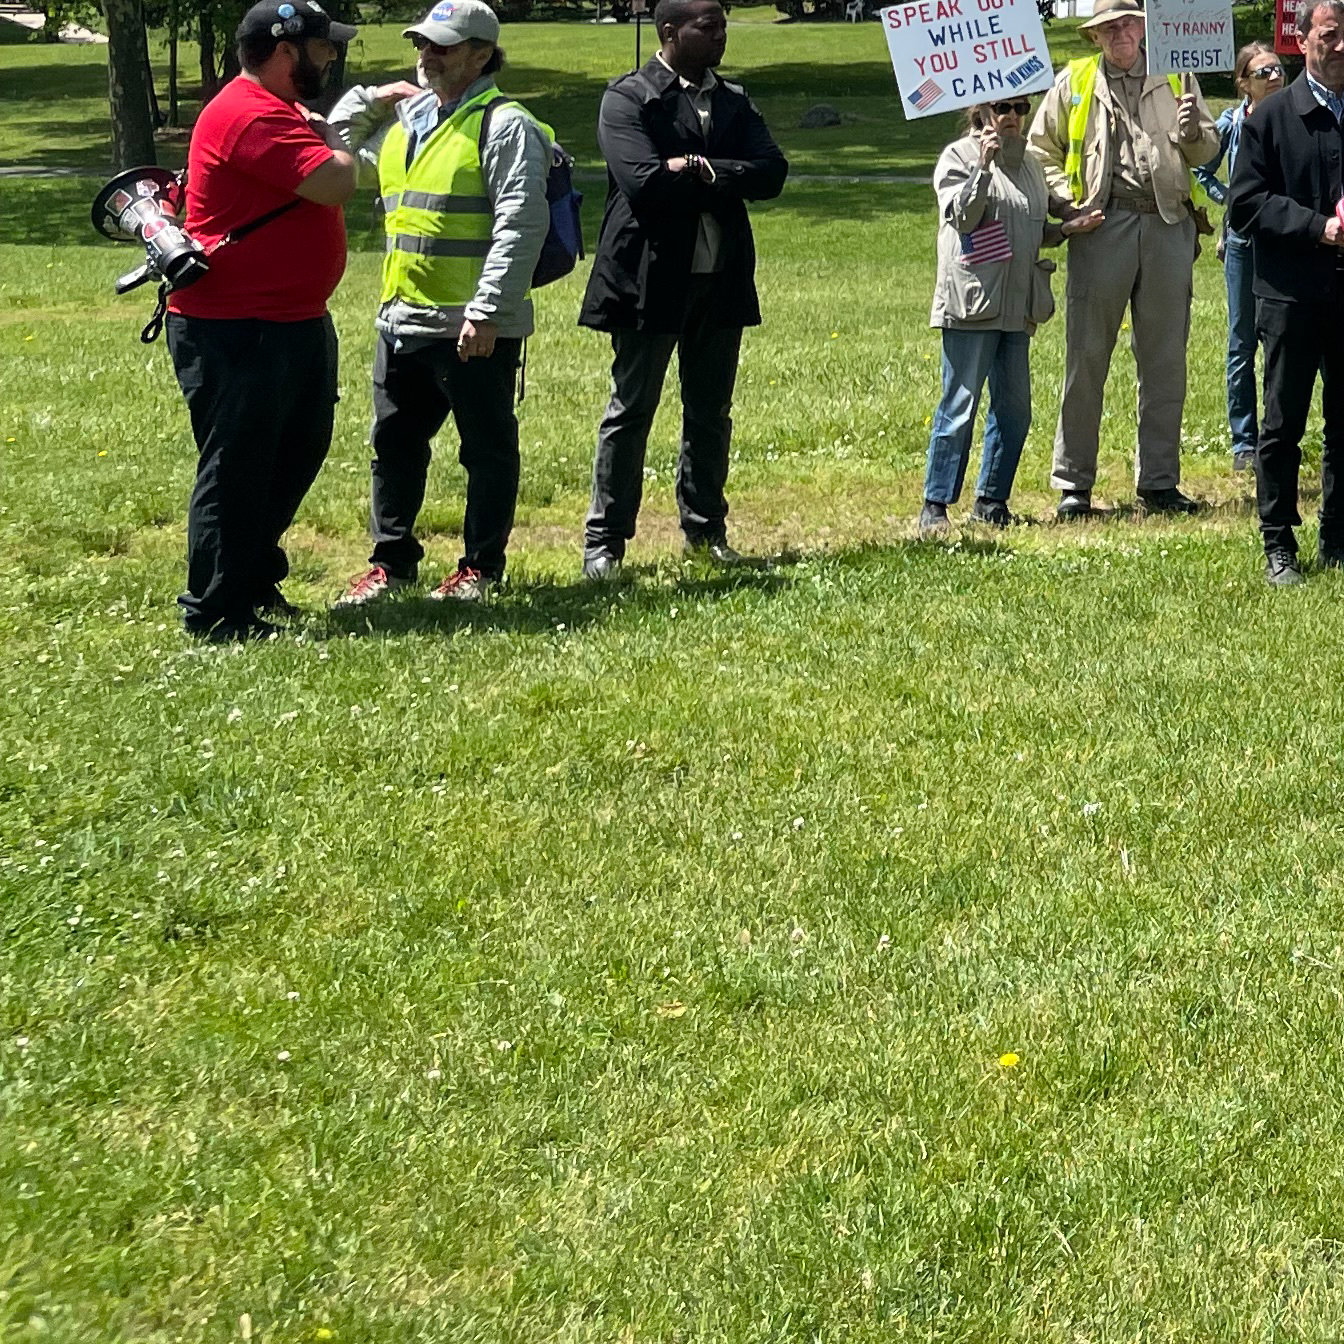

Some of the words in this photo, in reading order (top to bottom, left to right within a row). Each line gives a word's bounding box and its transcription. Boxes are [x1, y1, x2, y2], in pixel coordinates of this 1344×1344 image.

[928, 15, 1003, 47] WHILE
[1162, 22, 1226, 36] TYRANNY
[914, 50, 959, 76] YOU
[973, 34, 1035, 63] STILL
[1170, 49, 1222, 68] RESIST
[952, 69, 1004, 97] CAN
[1005, 72, 1022, 88] NO
[1017, 55, 1045, 80] KINGS
